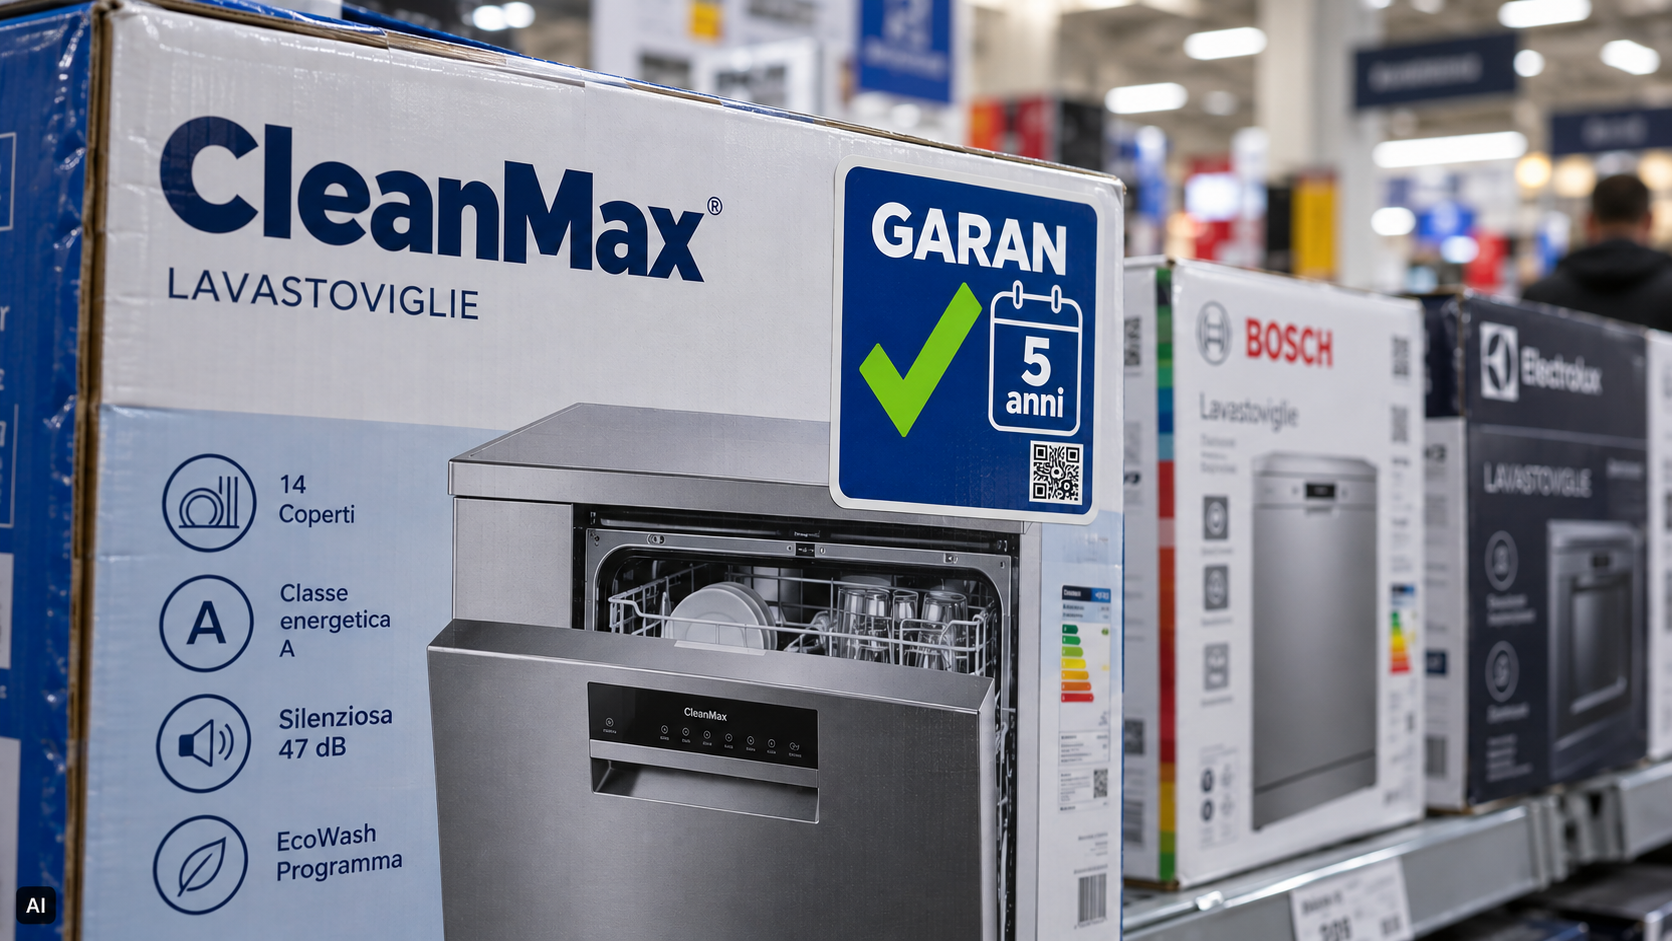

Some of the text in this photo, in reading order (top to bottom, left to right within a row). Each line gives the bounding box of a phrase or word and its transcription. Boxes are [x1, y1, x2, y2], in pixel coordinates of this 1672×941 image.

[871, 201, 1067, 276] GARAN
[168, 267, 479, 320] LAVASTOVIGLIE
[1245, 317, 1333, 368] BOSCH
[1020, 335, 1052, 387] 5
[1521, 346, 1603, 396] Electrolux
[1005, 386, 1064, 418] anni
[279, 474, 307, 495] 14
[278, 503, 356, 529] Coperti
[279, 583, 349, 604] Classe
[186, 600, 227, 645] A
[279, 608, 392, 635] energetica
[279, 639, 297, 659] A
[278, 705, 394, 731] Silenziosa
[683, 706, 729, 722] CleanMax
[278, 736, 348, 761] 47 dB
[276, 822, 377, 853] EcoWash
[276, 850, 404, 883] Programma
